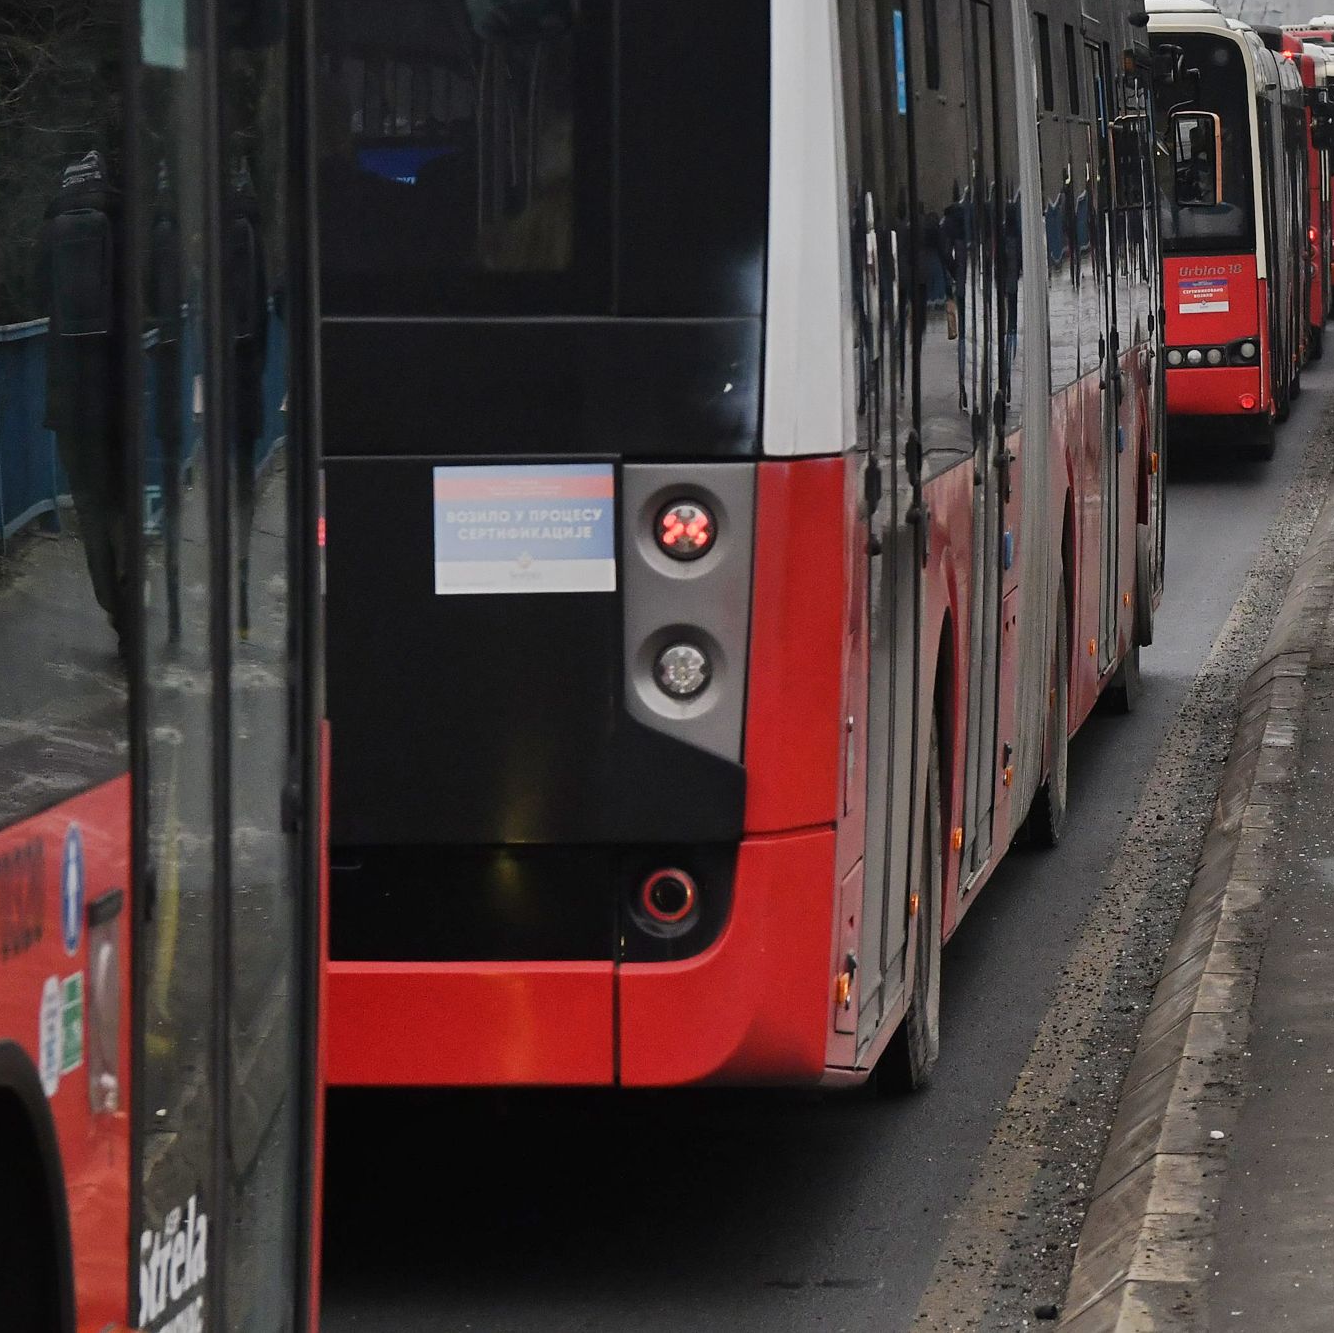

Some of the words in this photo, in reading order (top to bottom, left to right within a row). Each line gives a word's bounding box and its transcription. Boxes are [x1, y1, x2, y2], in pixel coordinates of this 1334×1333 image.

[1179, 266, 1226, 277] Urbino
[1229, 264, 1242, 274] 18
[446, 510, 511, 523] ВОЗИЛО
[515, 510, 524, 523] У
[529, 508, 603, 524] ПРОЦЕСУ
[458, 526, 593, 541] СЕРТИФИКАЦИЈЕ
